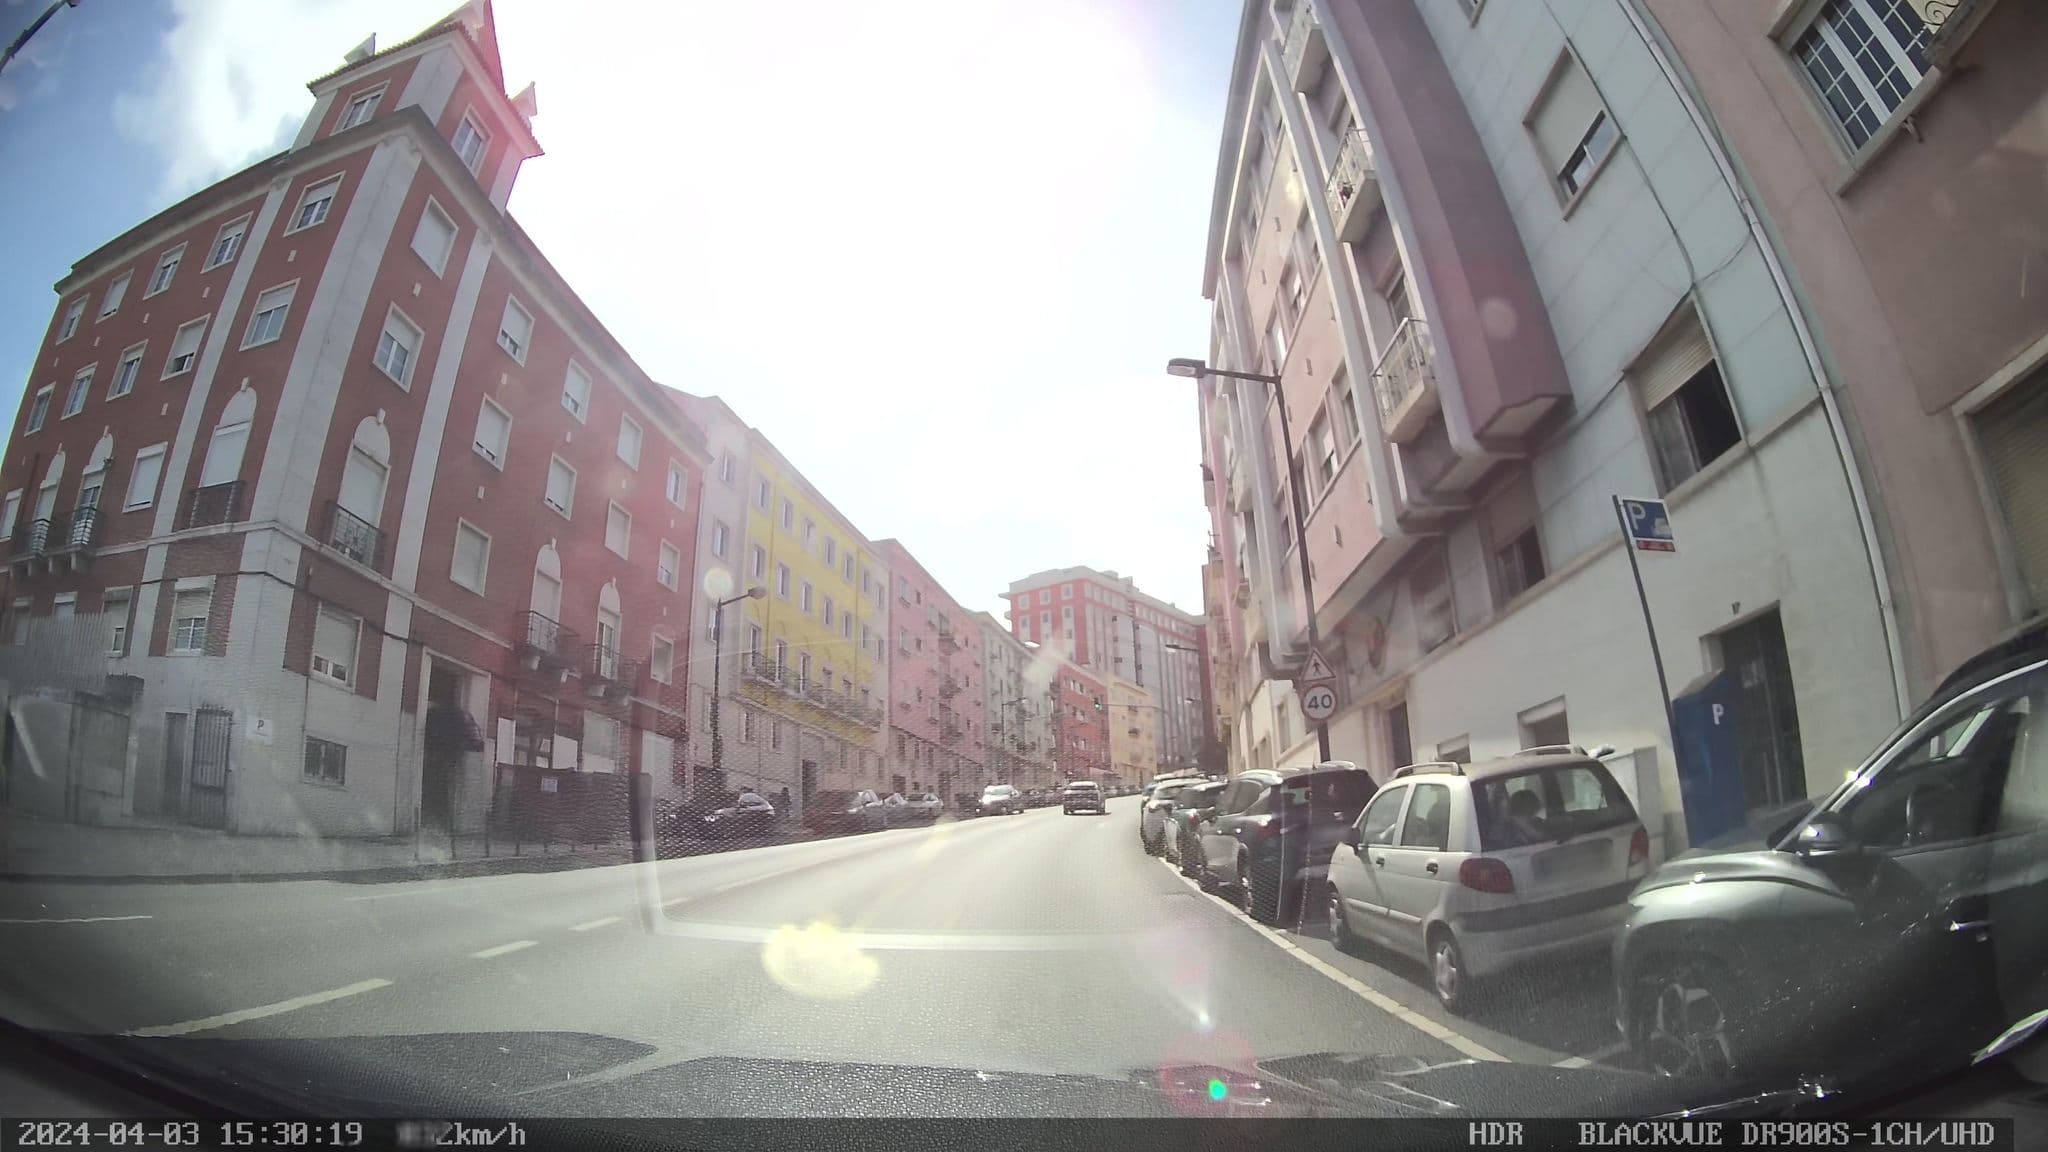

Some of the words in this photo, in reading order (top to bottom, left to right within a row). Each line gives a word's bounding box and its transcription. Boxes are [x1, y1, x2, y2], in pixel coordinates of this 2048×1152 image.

[1627, 502, 1646, 530] P
[1307, 694, 1333, 710] 40
[1712, 703, 1724, 725] P
